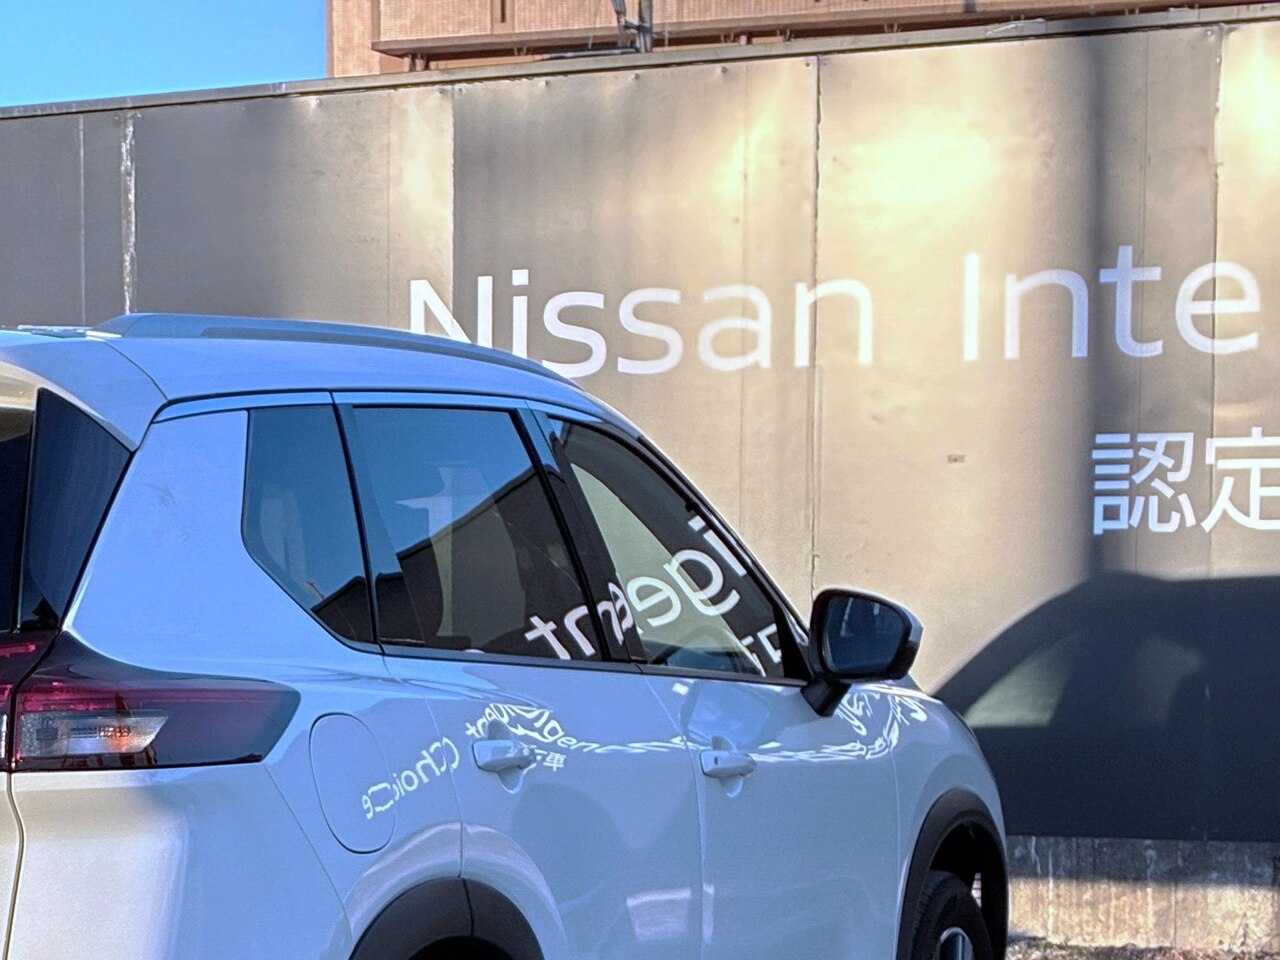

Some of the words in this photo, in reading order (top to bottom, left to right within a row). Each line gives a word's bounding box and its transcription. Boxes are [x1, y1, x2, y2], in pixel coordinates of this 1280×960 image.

[410, 269, 874, 379] Nissan
[961, 245, 1261, 362] Inte
[1091, 427, 1280, 535] 認定
